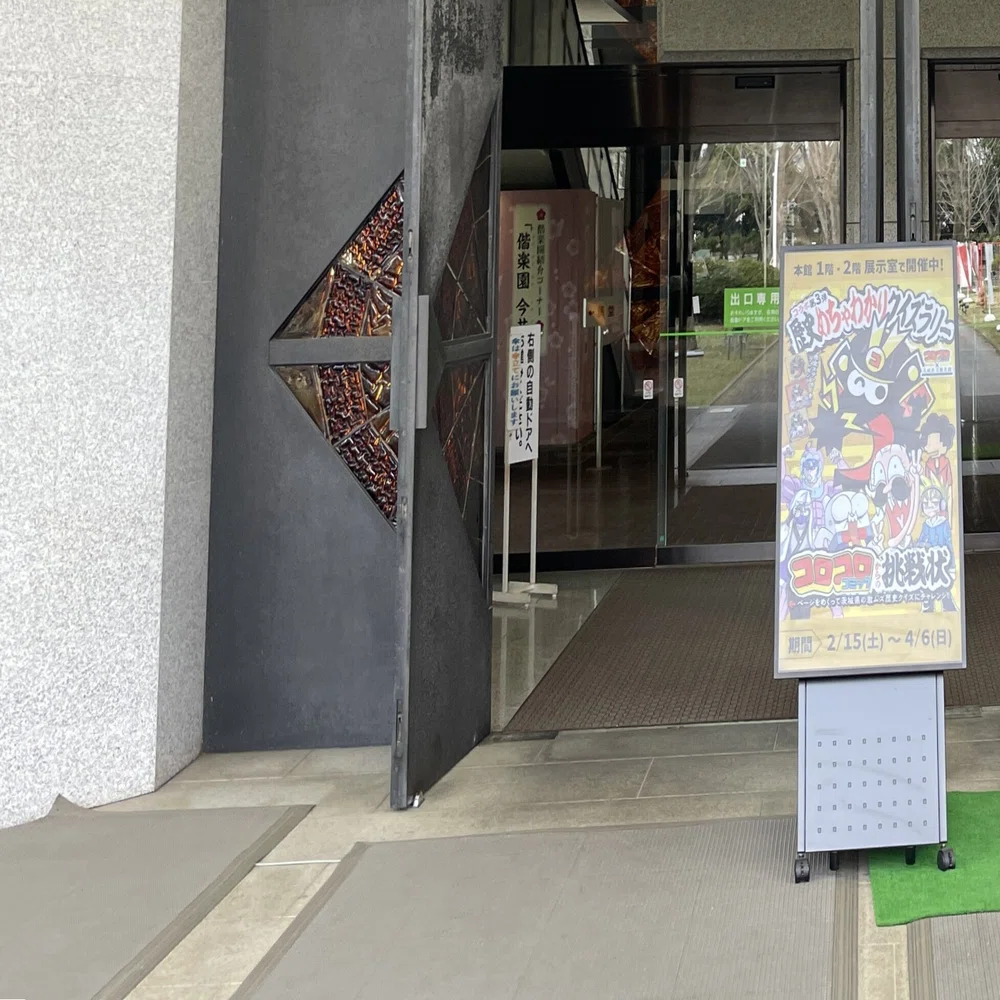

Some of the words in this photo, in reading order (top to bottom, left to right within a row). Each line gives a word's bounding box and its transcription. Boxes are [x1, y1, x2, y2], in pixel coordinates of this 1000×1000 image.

[793, 264, 813, 276] 本館
[525, 332, 536, 453] 右側の自動ドアへ
[788, 636, 813, 654] 期間
